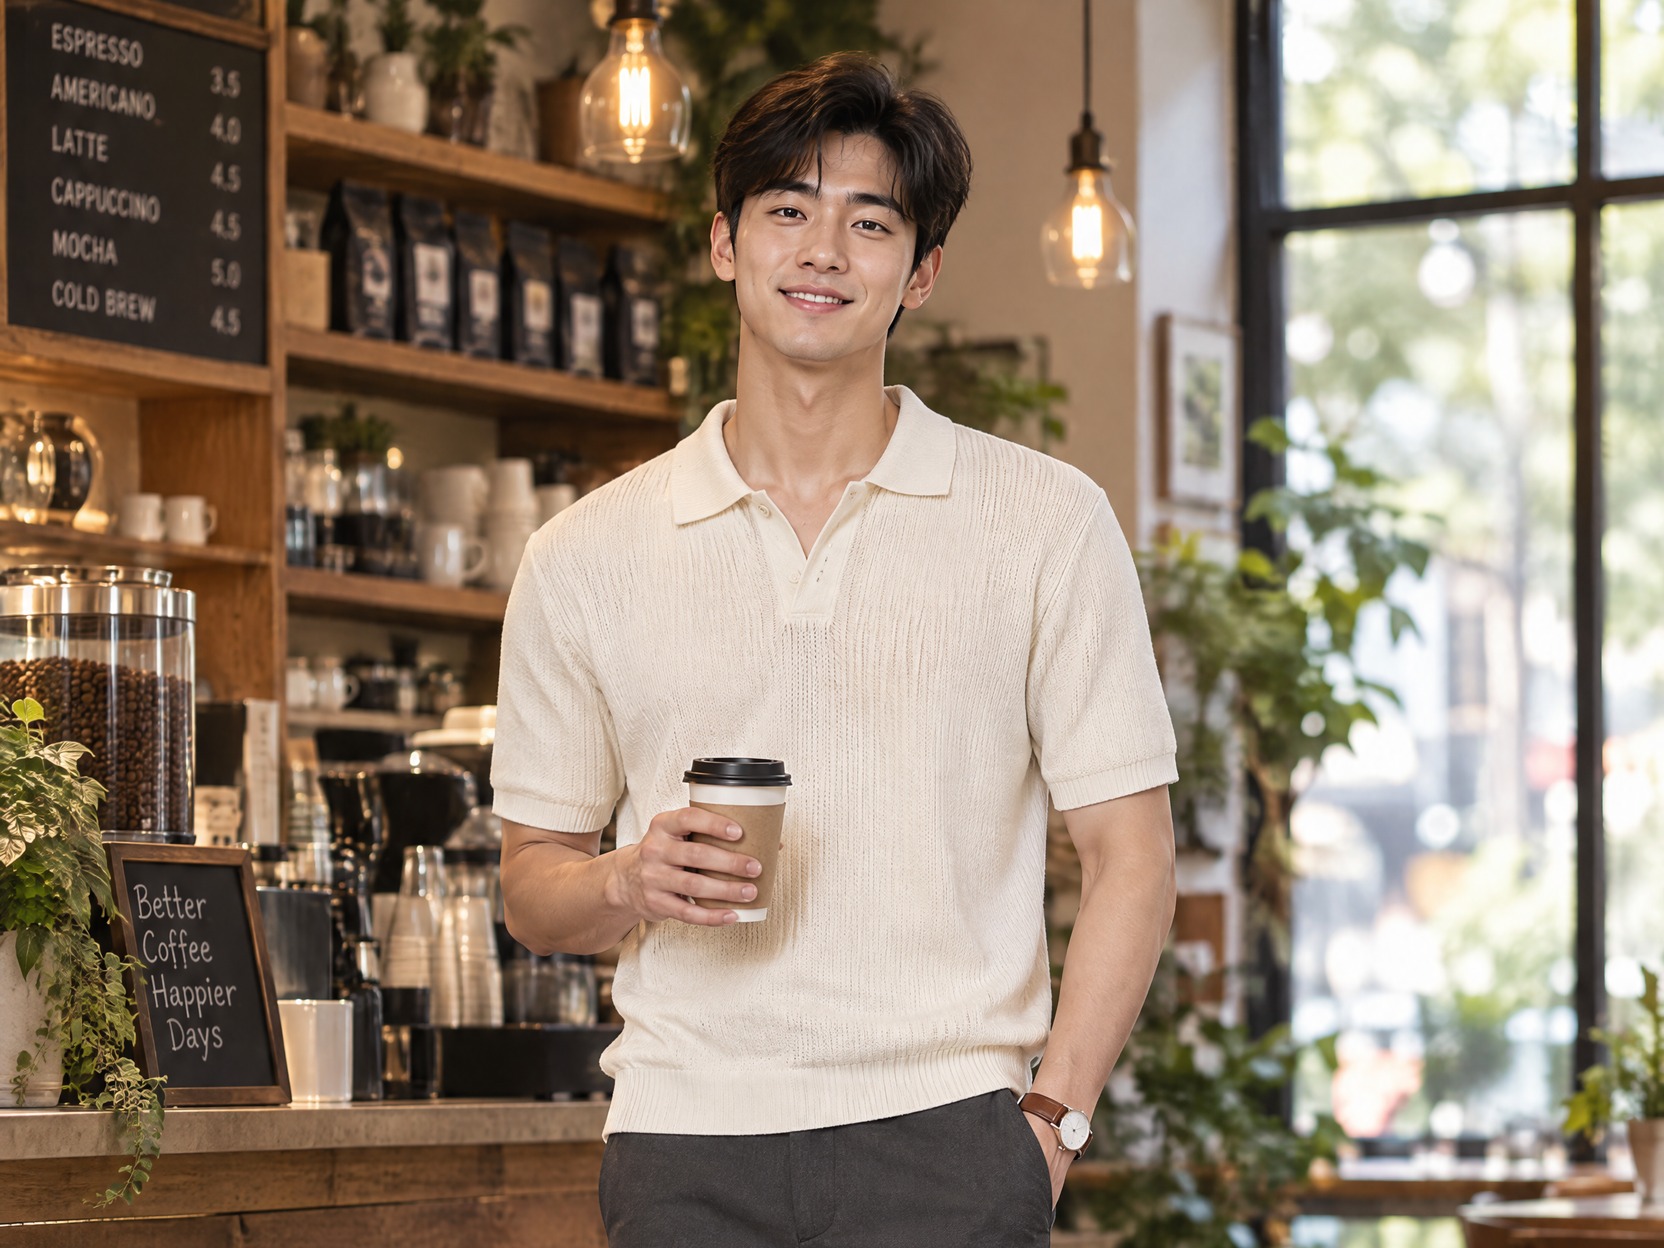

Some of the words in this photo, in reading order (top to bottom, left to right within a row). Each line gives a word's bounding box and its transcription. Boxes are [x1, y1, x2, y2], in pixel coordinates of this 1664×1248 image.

[51, 23, 144, 68] ESPRESSO
[210, 66, 241, 98] 3.5
[51, 73, 156, 121] AMERICANO
[210, 113, 242, 145] 4.0
[51, 125, 109, 163] LATTE
[210, 162, 242, 193] 4.5
[51, 177, 161, 224] CAPPUCCINO
[210, 210, 242, 241] 4.5
[52, 230, 119, 267] MOCHA
[211, 258, 242, 289] 5.0
[51, 280, 99, 312] COLD
[105, 289, 156, 323] BREW
[210, 306, 242, 337] 4.5
[133, 883, 207, 920] Better
[142, 929, 213, 969] Coffee
[150, 973, 237, 1019] Happier
[166, 1017, 224, 1062] Days
